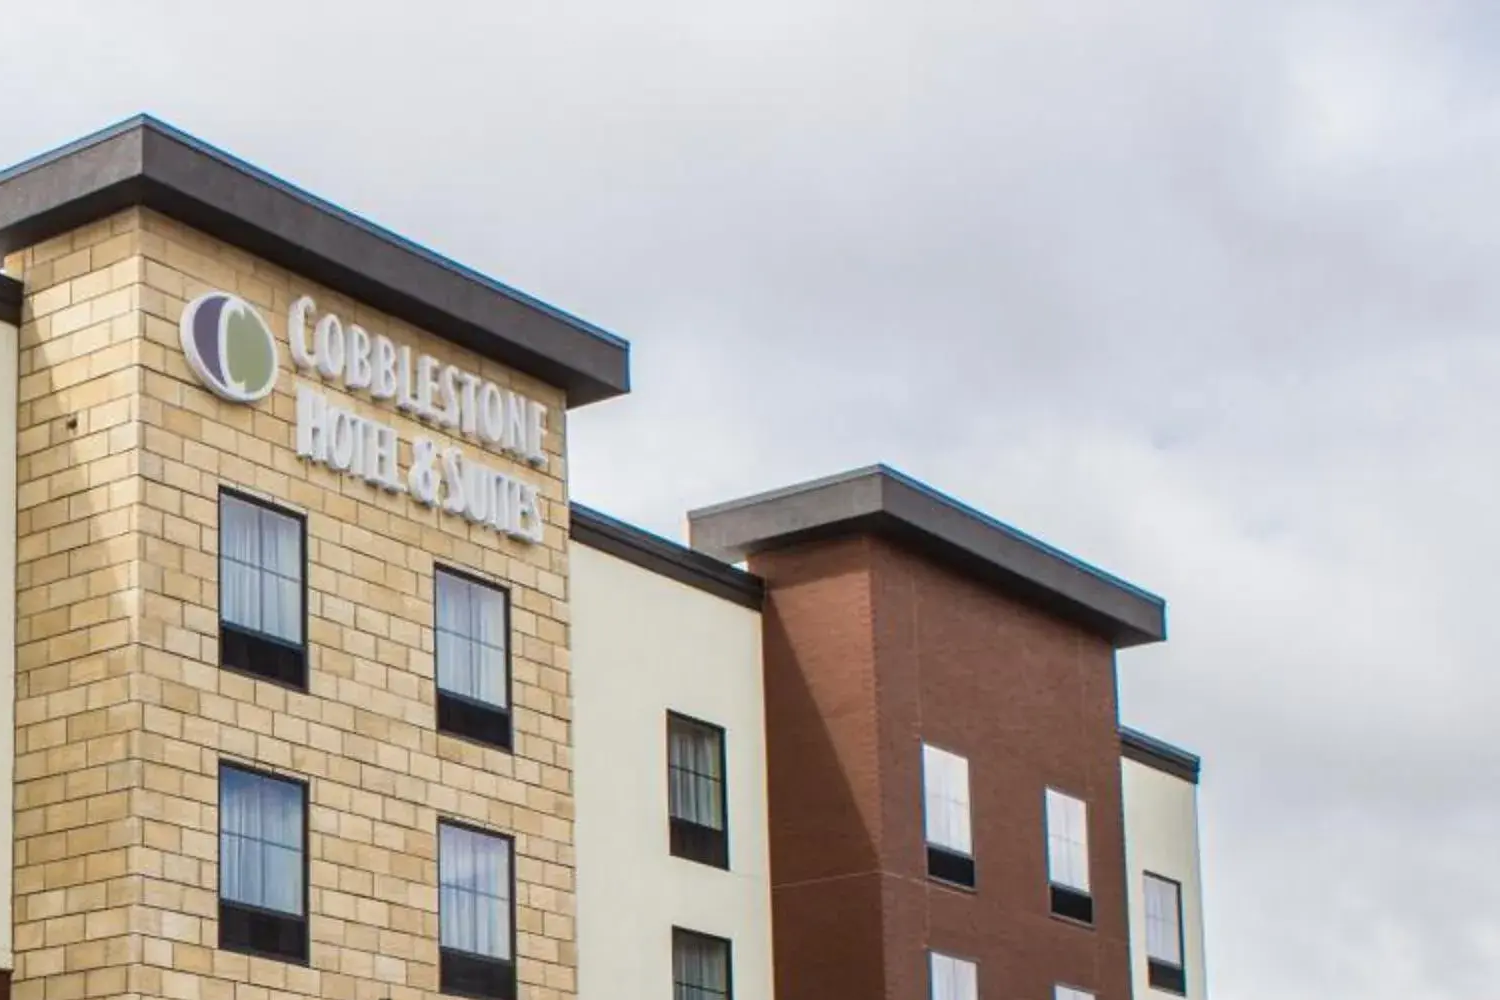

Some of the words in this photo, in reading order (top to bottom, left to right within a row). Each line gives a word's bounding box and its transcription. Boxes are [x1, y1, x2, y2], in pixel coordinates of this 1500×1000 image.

[288, 295, 548, 466] COBBLESTONE
[296, 384, 408, 494] HOTEL
[408, 436, 441, 508] &
[442, 445, 544, 545] SUITES
